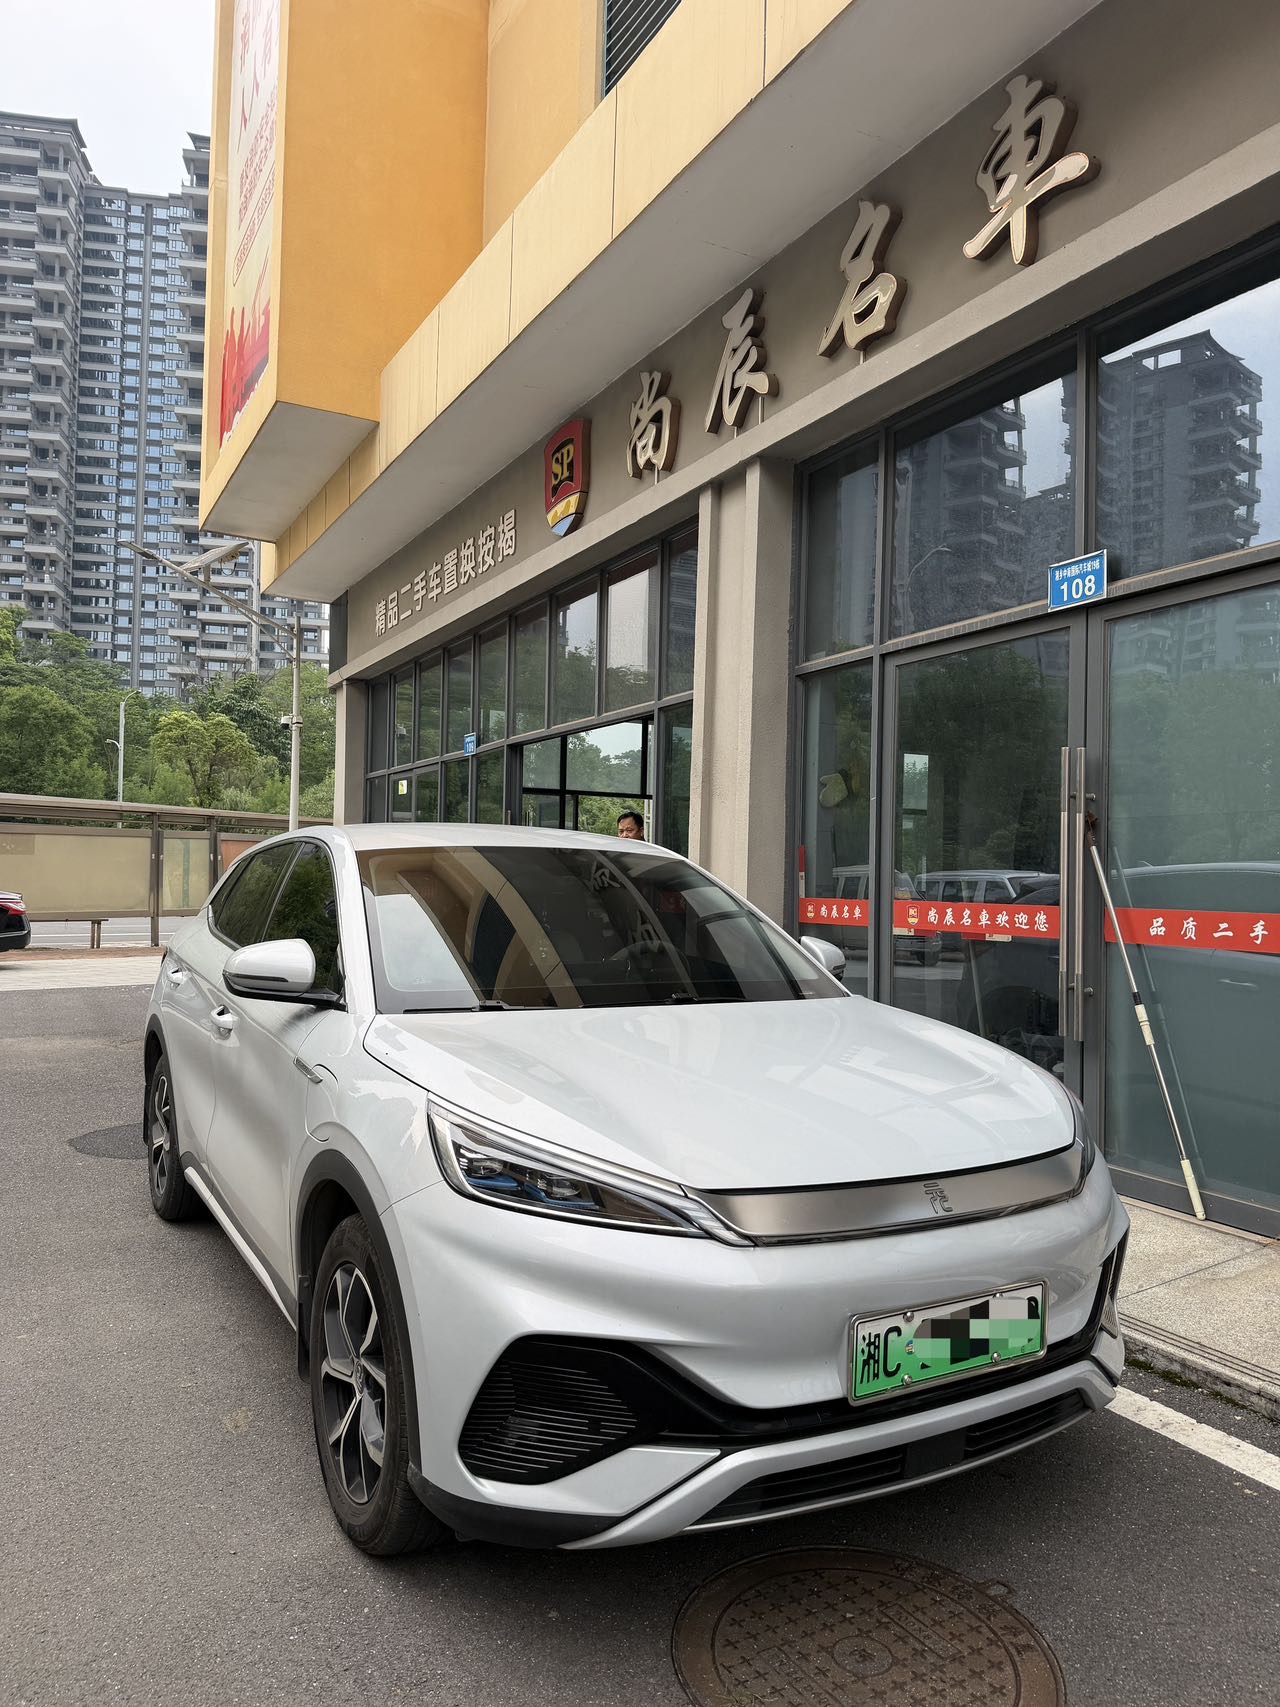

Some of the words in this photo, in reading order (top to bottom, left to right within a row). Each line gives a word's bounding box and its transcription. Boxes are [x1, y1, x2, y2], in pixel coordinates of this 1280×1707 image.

[551, 443, 575, 486] SP
[375, 509, 517, 637] 精品二手车置换按揭
[1060, 574, 1096, 602] 108
[927, 906, 1049, 932] 尚辰名車欢迎您
[1149, 917, 1269, 944] 品质二手
